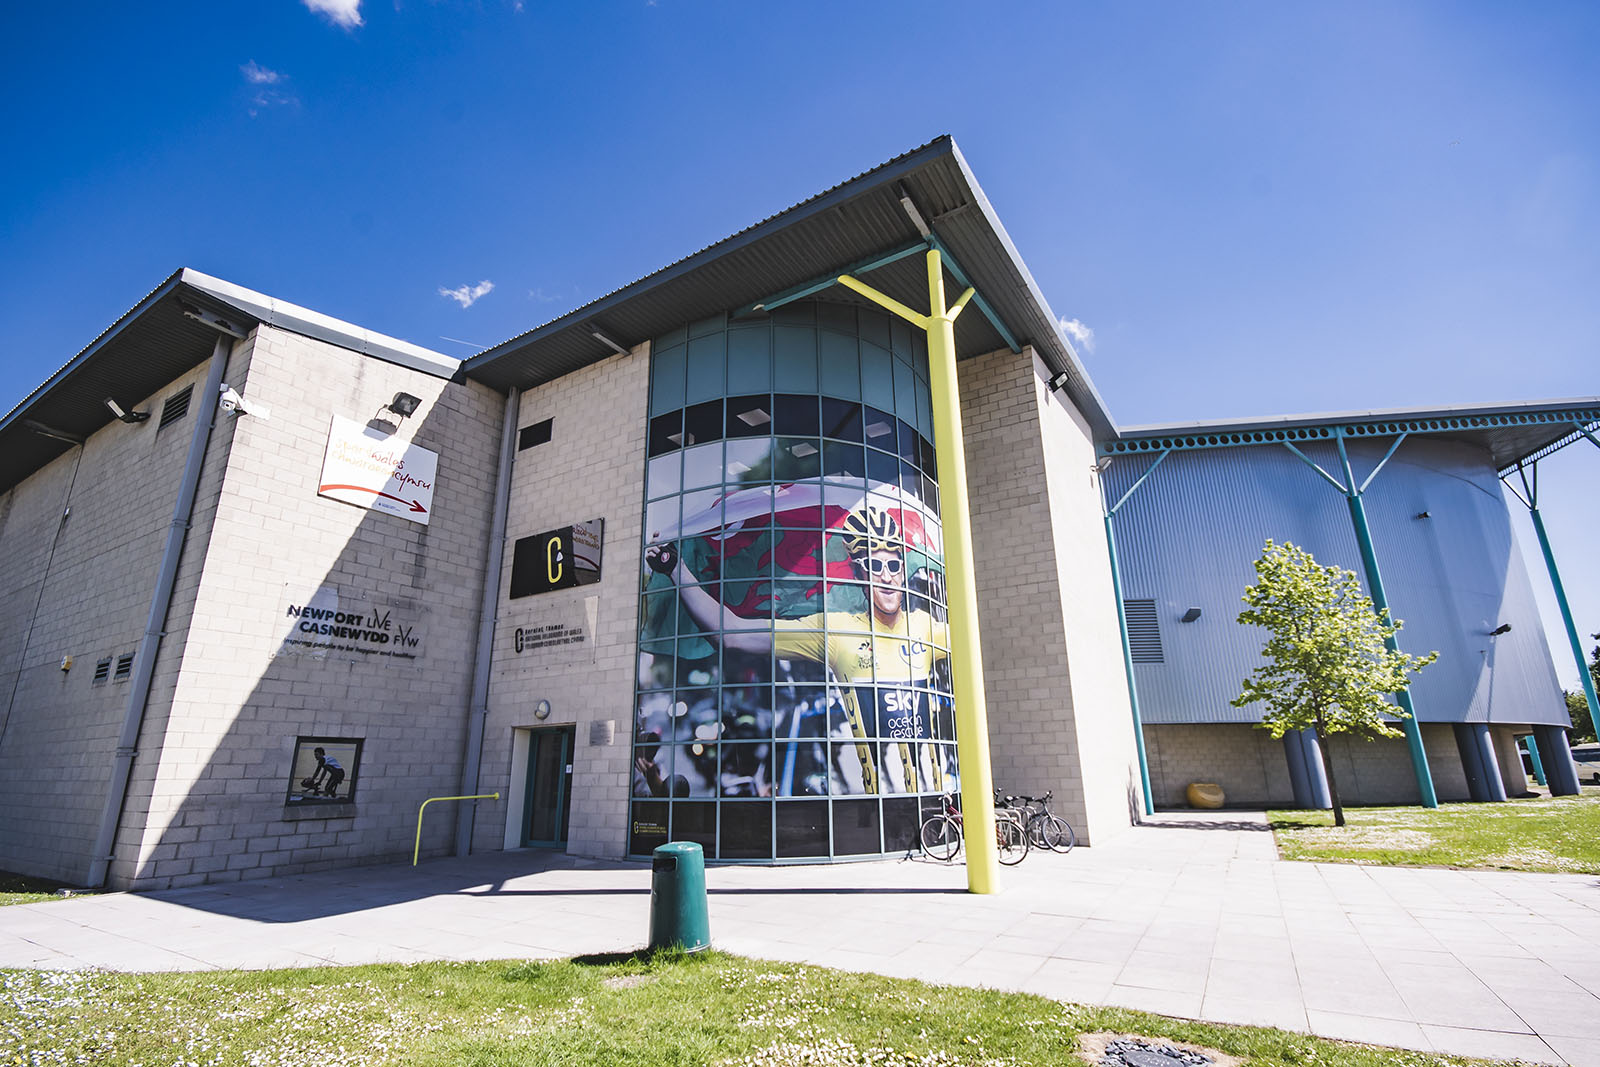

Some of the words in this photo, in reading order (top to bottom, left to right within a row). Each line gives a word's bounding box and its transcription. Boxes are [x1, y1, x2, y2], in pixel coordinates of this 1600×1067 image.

[286, 605, 363, 626] NEWPORT
[367, 608, 391, 631] LIVE
[300, 621, 389, 643] CASNEWYDD
[394, 625, 419, 647] FYW
[313, 641, 336, 650] people
[901, 641, 926, 657] LCL
[884, 685, 921, 714] sky
[888, 714, 923, 729] ocean
[889, 726, 924, 739] rescue
